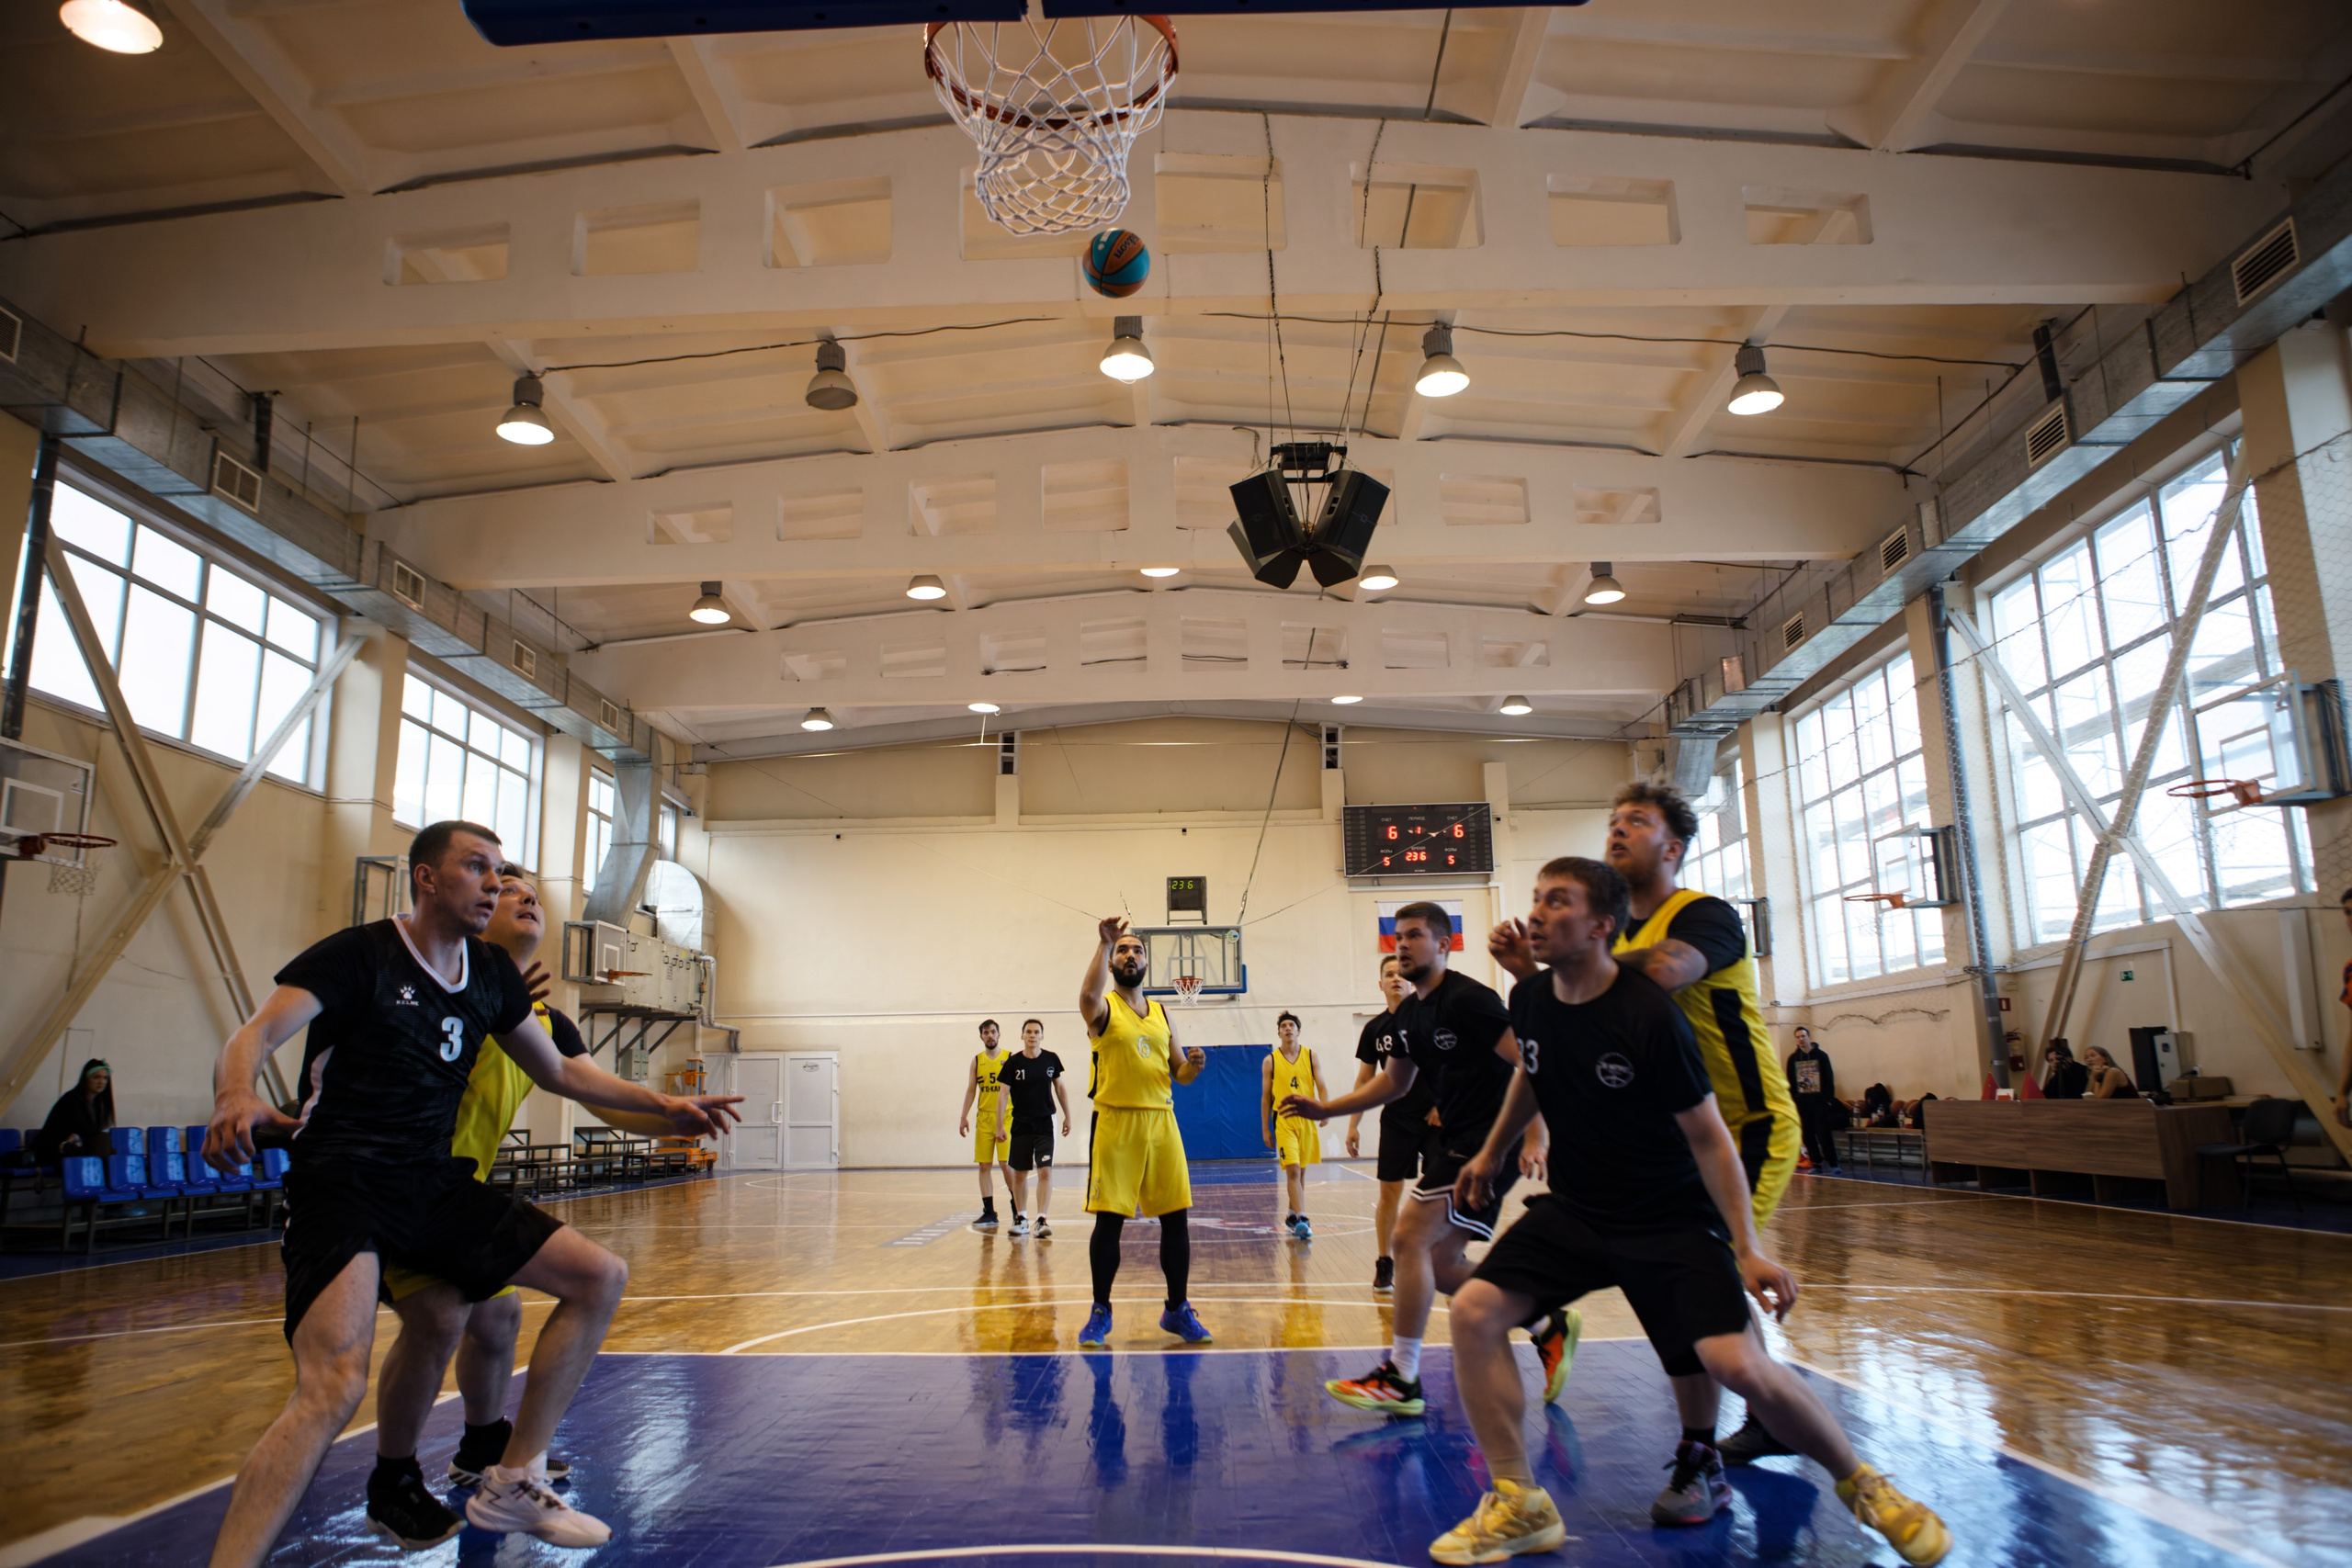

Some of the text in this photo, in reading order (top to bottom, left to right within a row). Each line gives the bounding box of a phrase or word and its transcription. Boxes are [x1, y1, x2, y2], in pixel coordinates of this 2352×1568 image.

[1387, 825, 1398, 840] 6
[1453, 823, 1464, 839] 6
[1383, 856, 1391, 866] 5
[1447, 854, 1455, 865] 5
[439, 1016, 464, 1062] 3
[1375, 1034, 1393, 1053] 48
[1137, 1035, 1151, 1058] 6
[1517, 1037, 1539, 1075] 3
[989, 1073, 996, 1084] 5
[1015, 1069, 1025, 1080] 21
[1290, 1077, 1299, 1089] 4
[1280, 1146, 1286, 1160] 4
